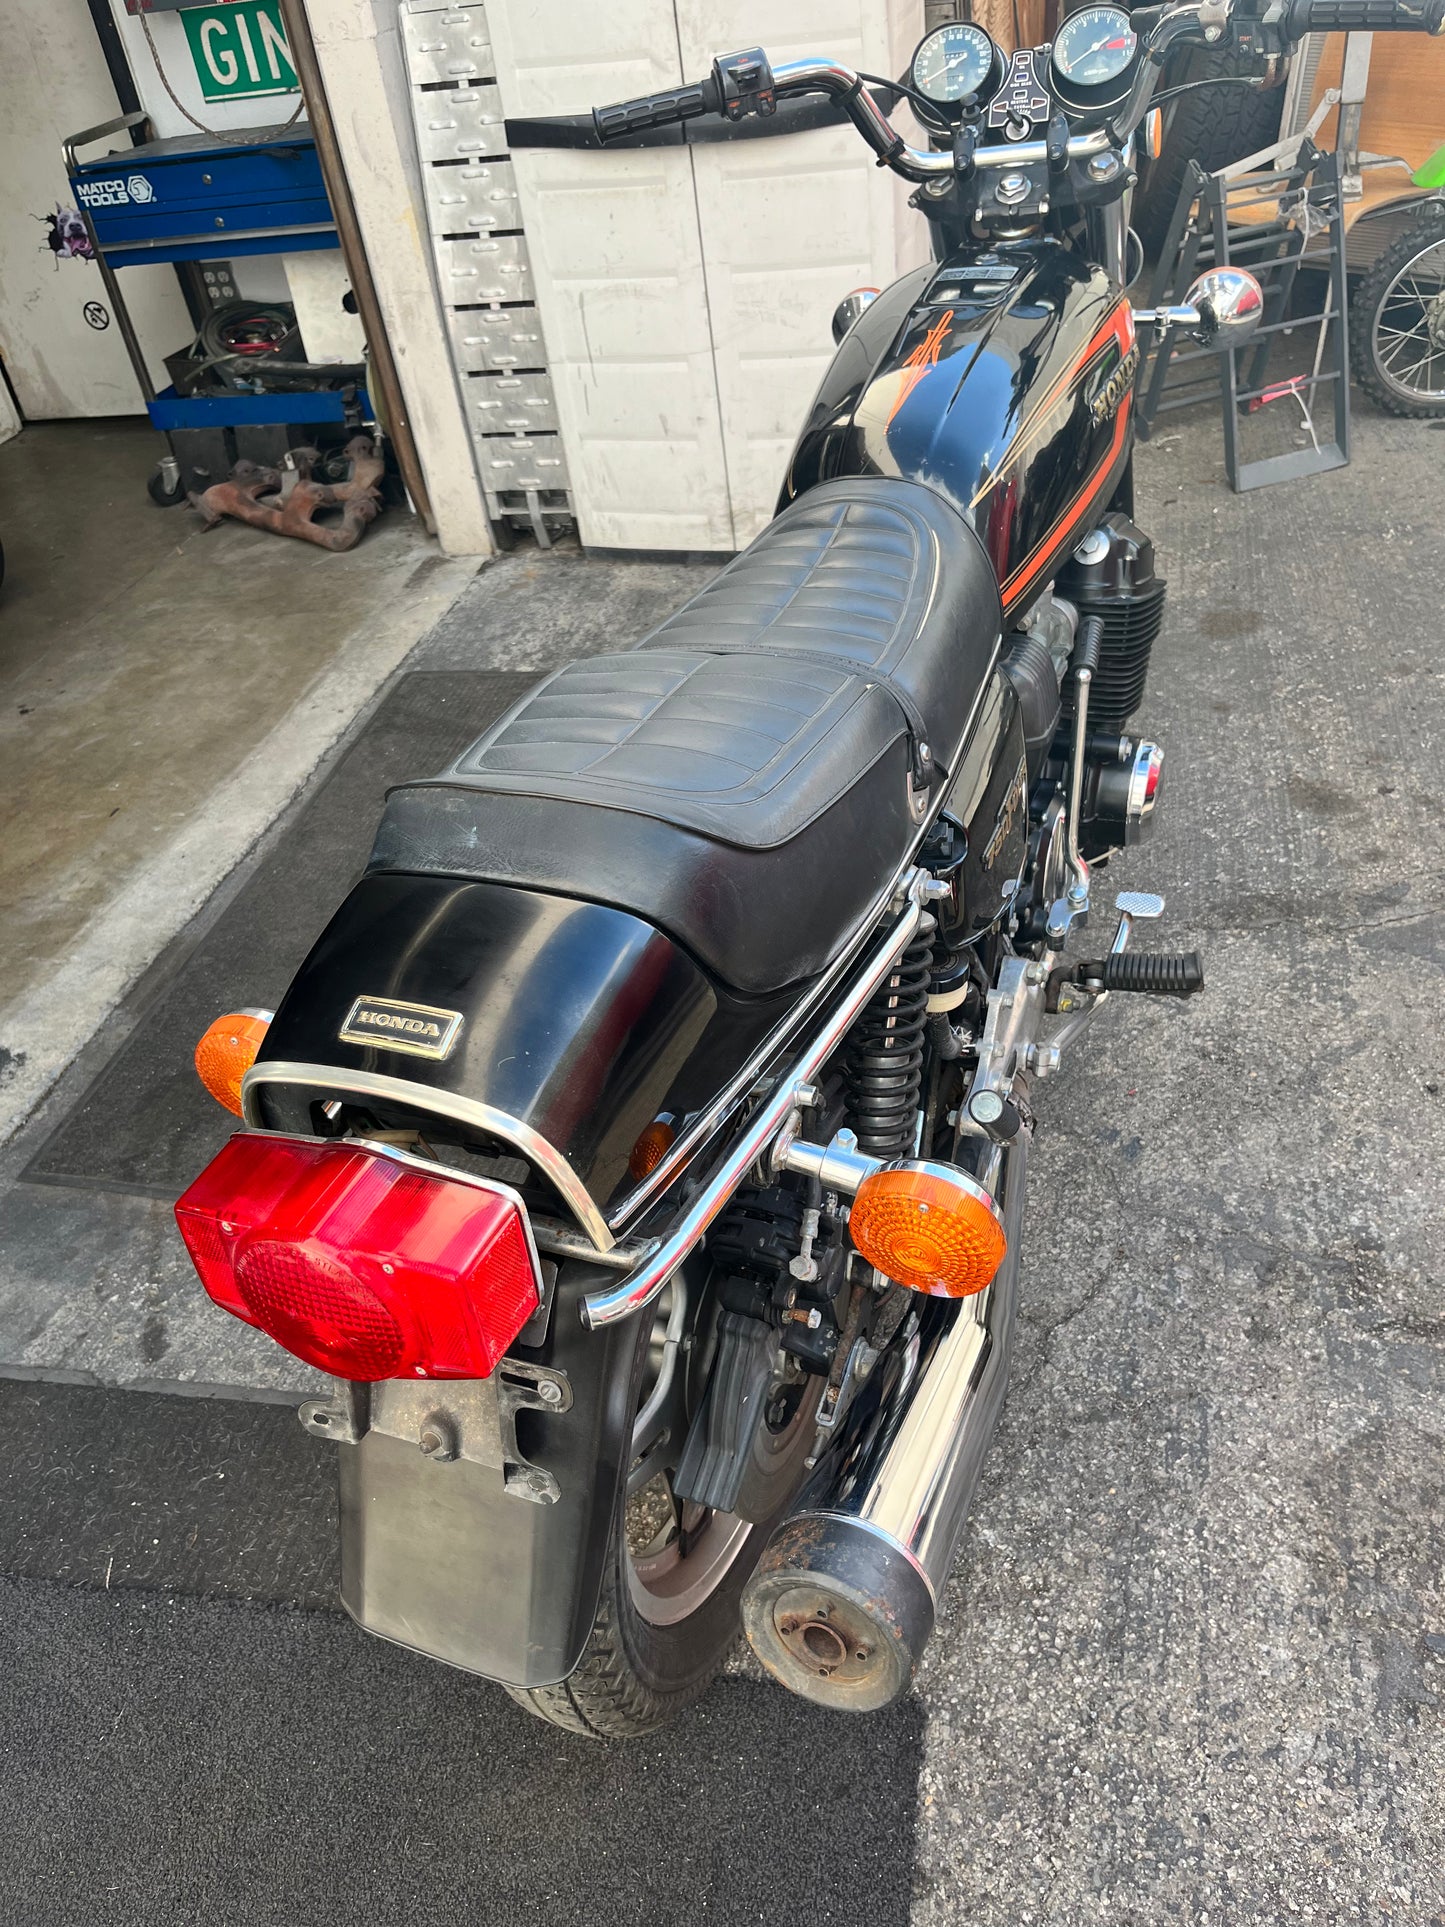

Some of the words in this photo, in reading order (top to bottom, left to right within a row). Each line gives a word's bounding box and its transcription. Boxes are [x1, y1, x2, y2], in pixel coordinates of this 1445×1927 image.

[200, 10, 300, 86] GIN
[76, 179, 126, 196] MATCO
[80, 191, 130, 207] TOOLS
[357, 1010, 440, 1037] HONDA
